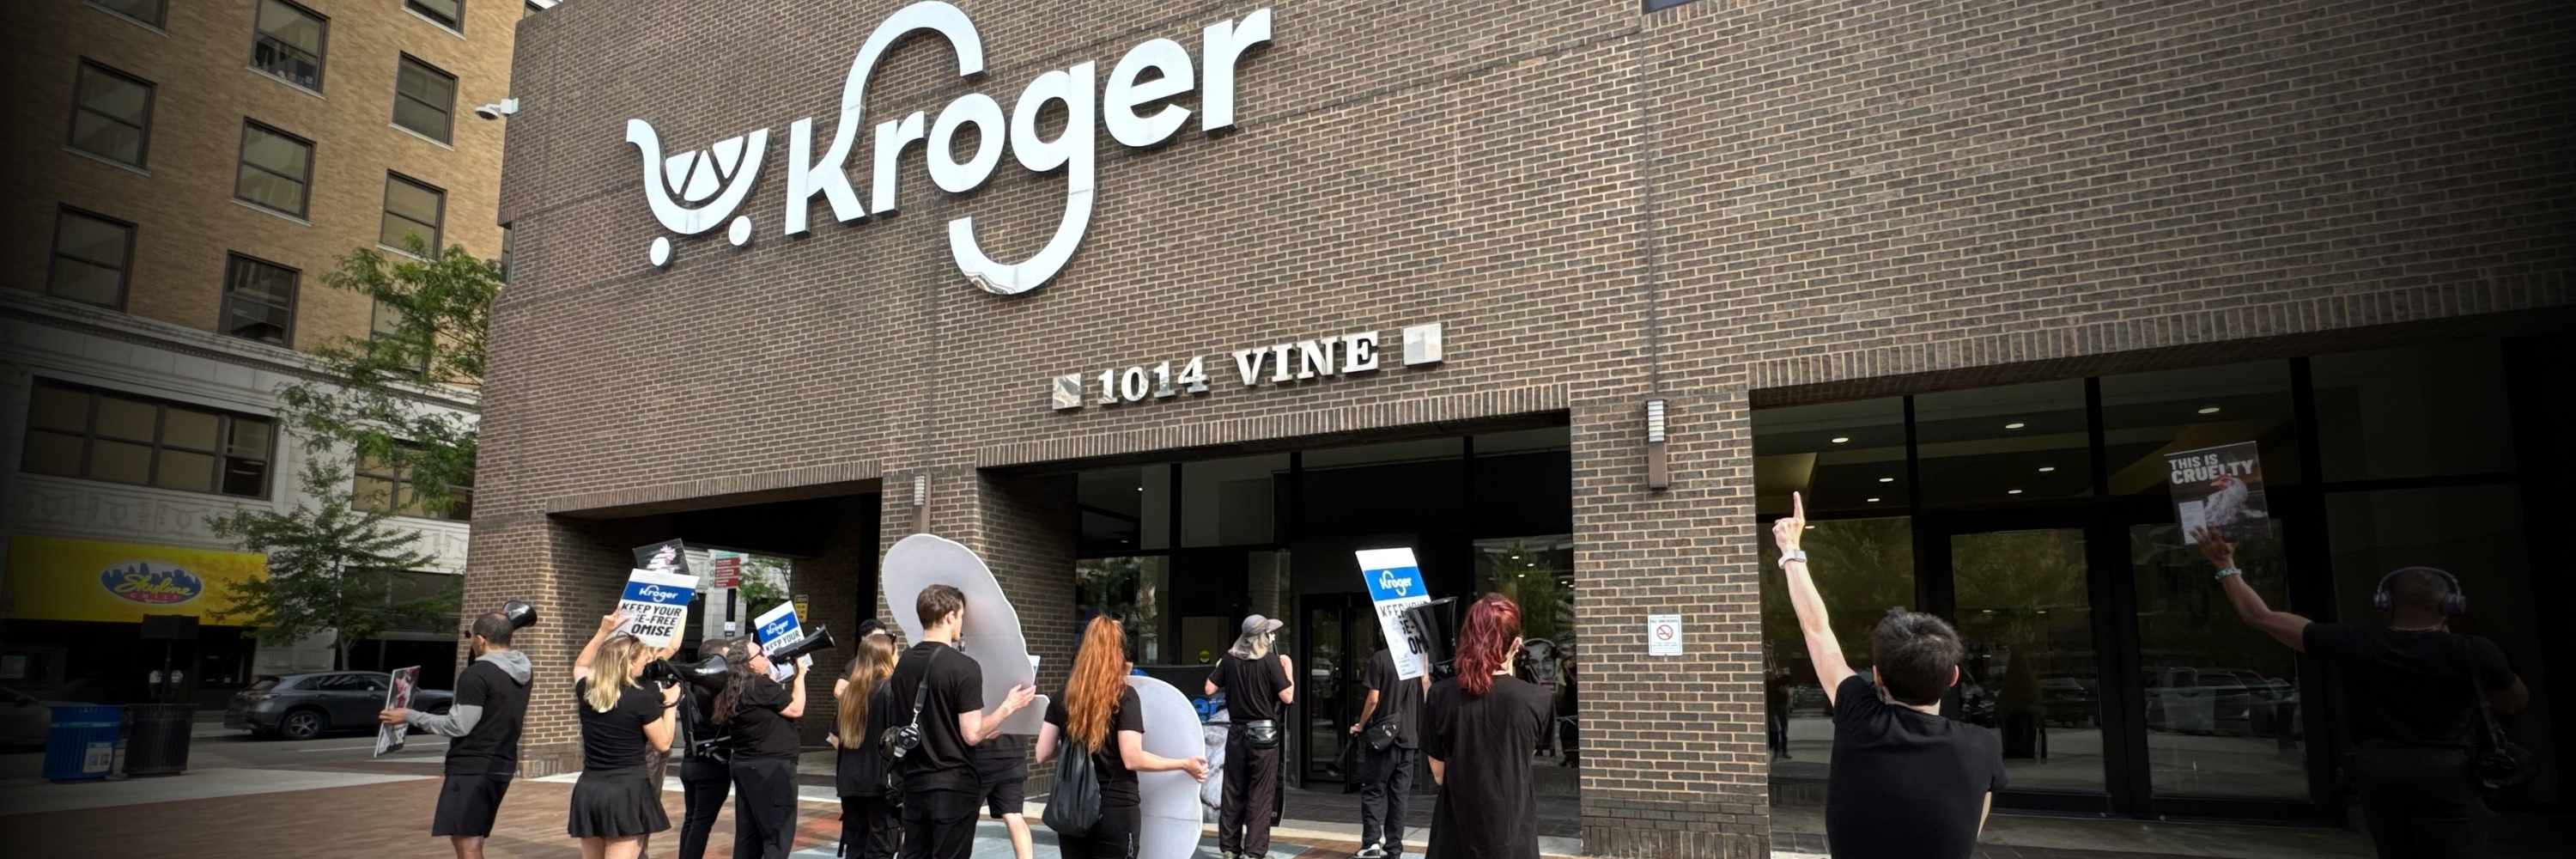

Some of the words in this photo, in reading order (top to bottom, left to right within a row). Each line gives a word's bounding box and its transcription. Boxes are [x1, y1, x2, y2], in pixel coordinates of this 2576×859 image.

[784, 0, 1272, 295] Kroger
[1097, 355, 1209, 405] 1014
[1231, 331, 1379, 386] VINE
[2169, 456, 2201, 470] THIS
[2204, 454, 2218, 466] IS
[2171, 460, 2253, 484] CRUELTY
[1379, 570, 1412, 596] Kroger
[639, 585, 678, 602] Kroger
[622, 603, 652, 613] KEEP
[653, 606, 682, 617] YOUR
[631, 624, 674, 637] OMISE
[782, 630, 800, 644] YOUR
